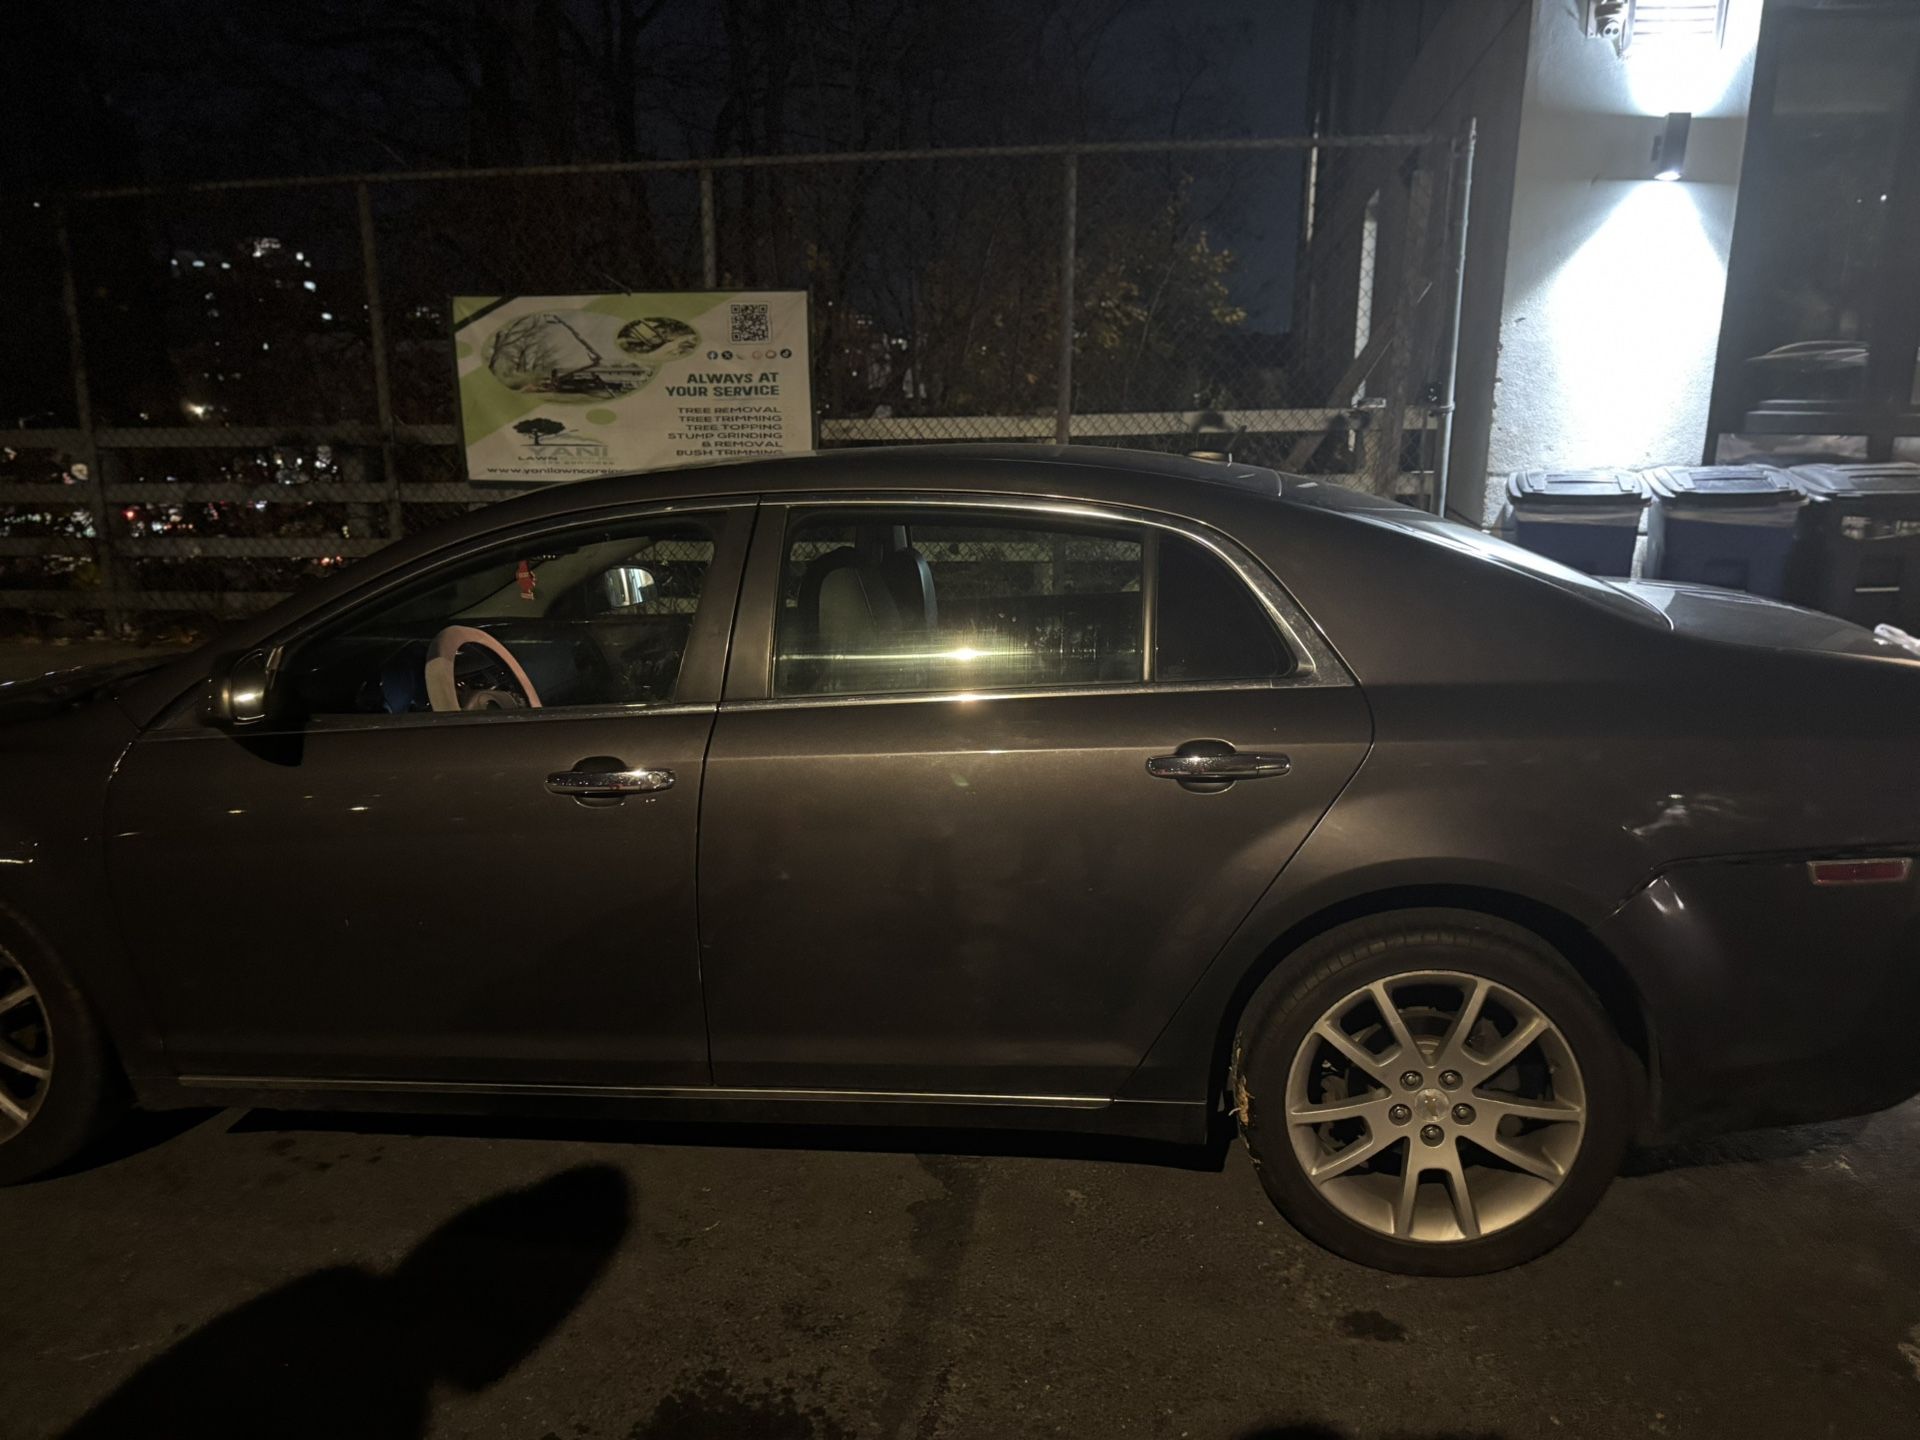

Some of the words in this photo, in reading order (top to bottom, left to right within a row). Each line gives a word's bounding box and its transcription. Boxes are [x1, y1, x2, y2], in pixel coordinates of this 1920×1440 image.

[687, 373, 753, 384] ALWAYS
[758, 372, 780, 383] AT
[665, 386, 708, 397] YOUR
[713, 385, 780, 396] SERVICE
[667, 432, 714, 440] STUMP
[528, 447, 608, 457] YANI
